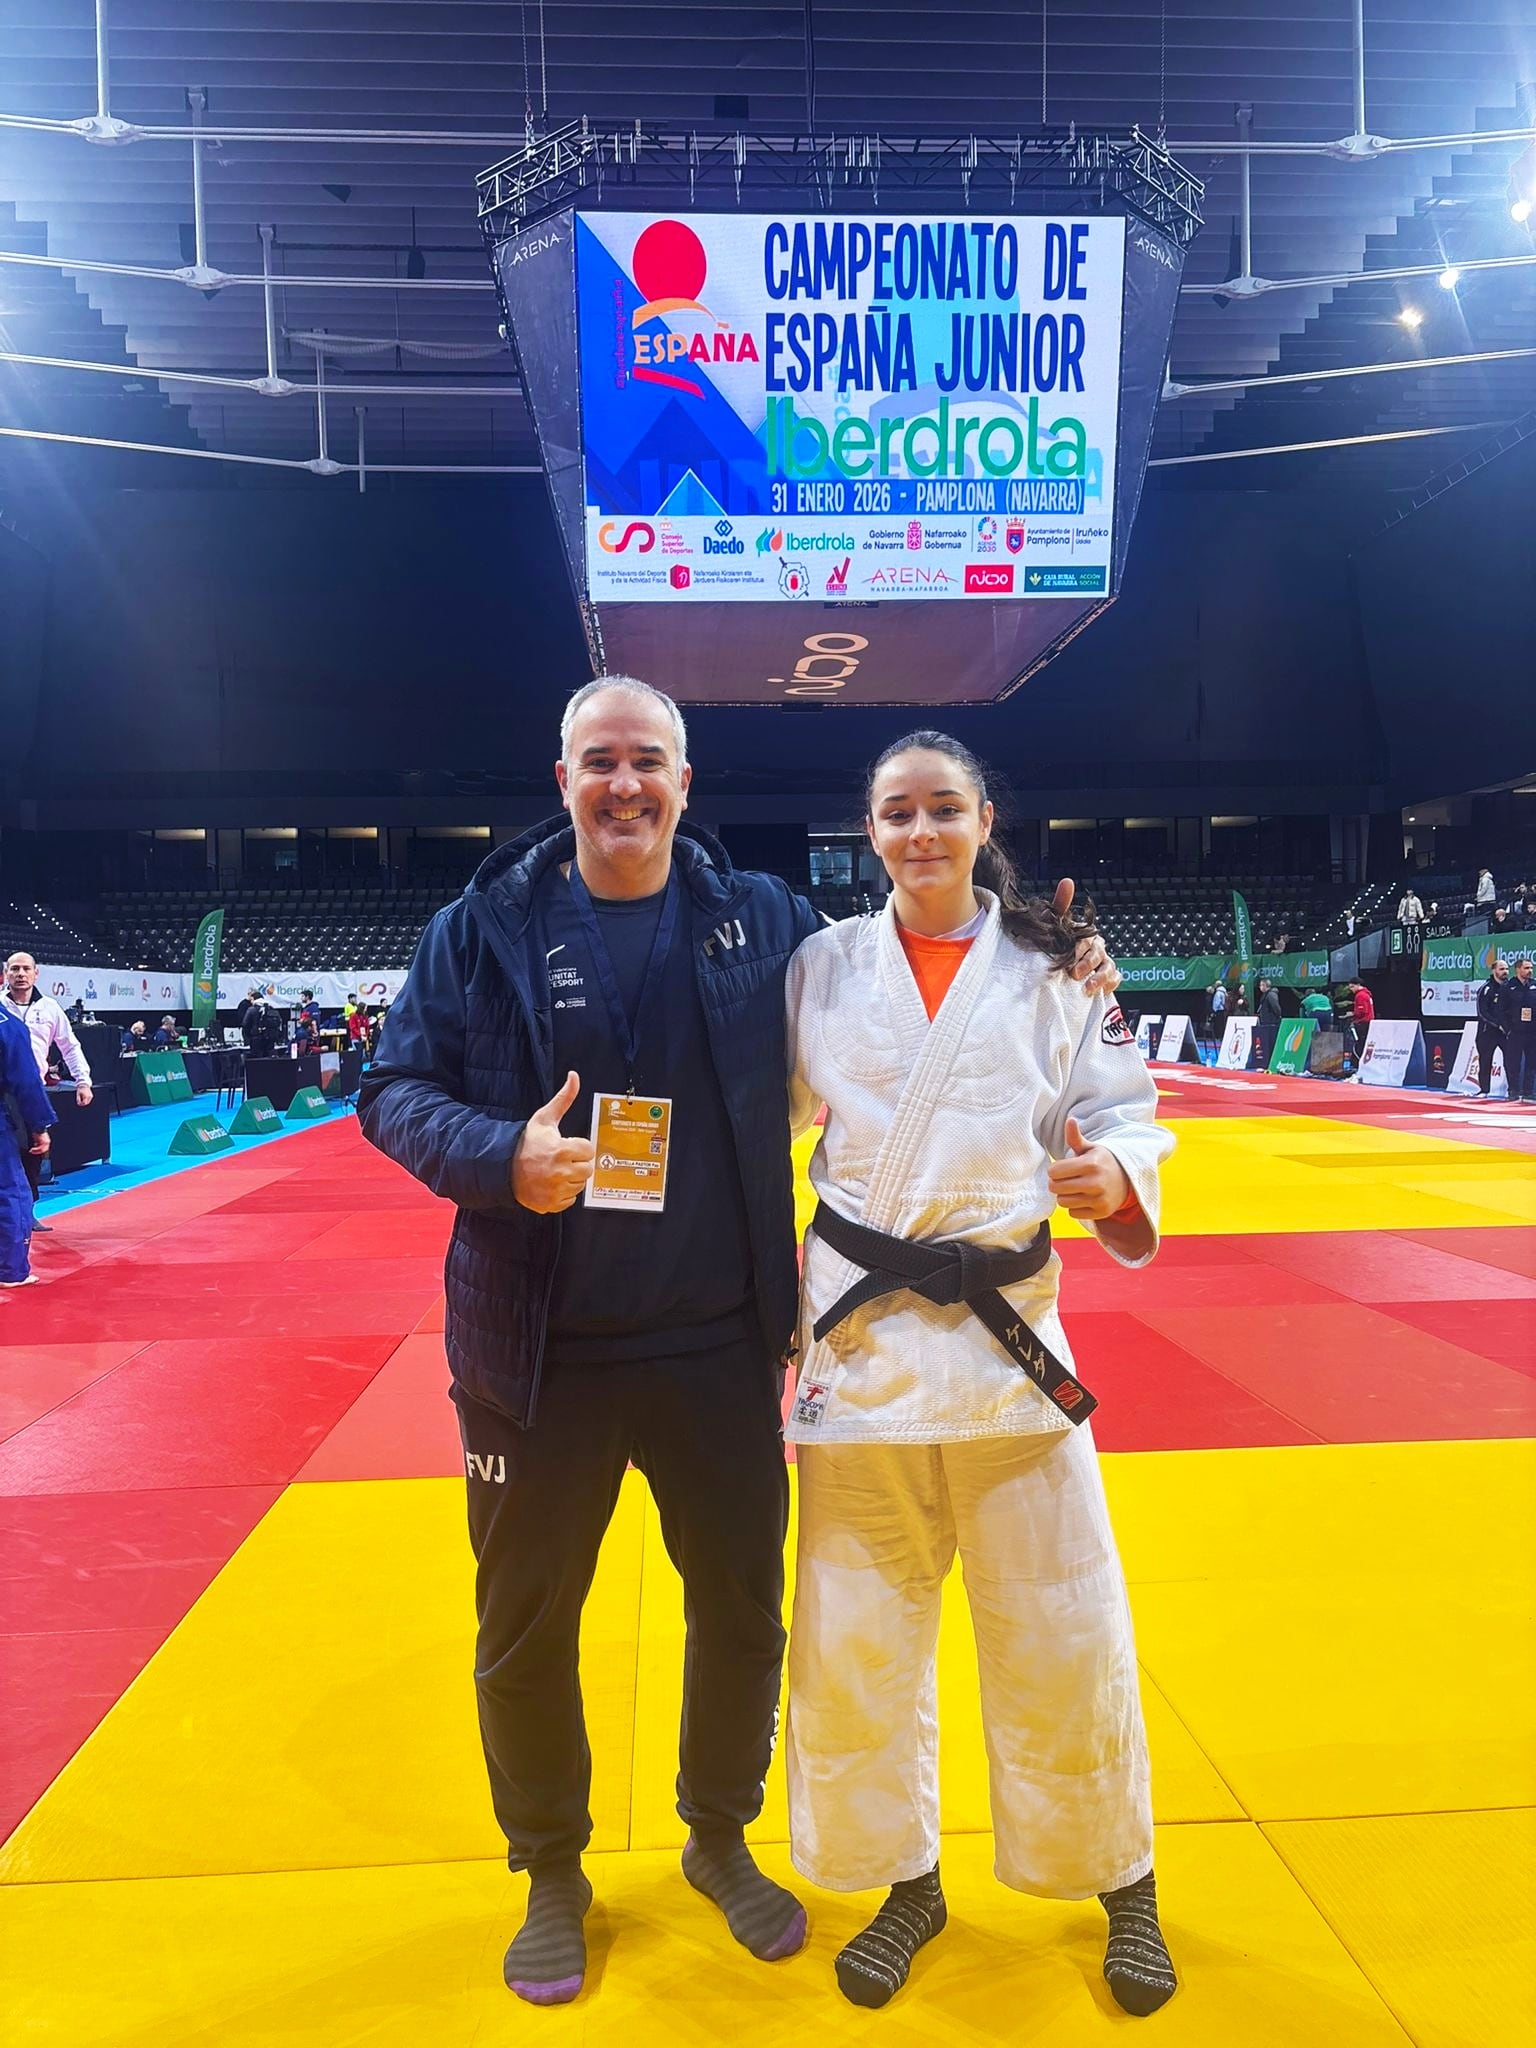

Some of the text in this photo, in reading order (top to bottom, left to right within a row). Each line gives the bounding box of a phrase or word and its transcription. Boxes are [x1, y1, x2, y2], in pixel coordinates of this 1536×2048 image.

[511, 233, 562, 267] ARENA
[1135, 236, 1174, 270] ARENA
[764, 222, 1089, 301] CAMPEONATO DE
[633, 321, 760, 364] ESPAÑA
[765, 305, 1085, 393] ESPAÑA JUNIOR
[766, 396, 1087, 477] Iberdrola
[772, 482, 788, 512] 31
[797, 482, 845, 512] ENERO
[853, 481, 891, 512] 2026
[916, 481, 996, 513] PAMPLONA
[1005, 478, 1083, 515] (NAVARRA)
[786, 533, 855, 551] Iberdrola
[869, 529, 905, 539] Gobierno
[924, 529, 967, 538] Nafarroako
[1027, 535, 1070, 547] Pamplona
[703, 536, 745, 554] Daedo
[862, 541, 904, 549] de Navarra
[924, 541, 962, 549] Gobernua
[871, 567, 950, 583] ARENA
[1426, 925, 1452, 938] SALIDA
[201, 924, 216, 980] Iberdrola
[549, 971, 577, 981] UNITAT
[1117, 965, 1186, 981] berdrola
[465, 1450, 506, 1484] FVJ
